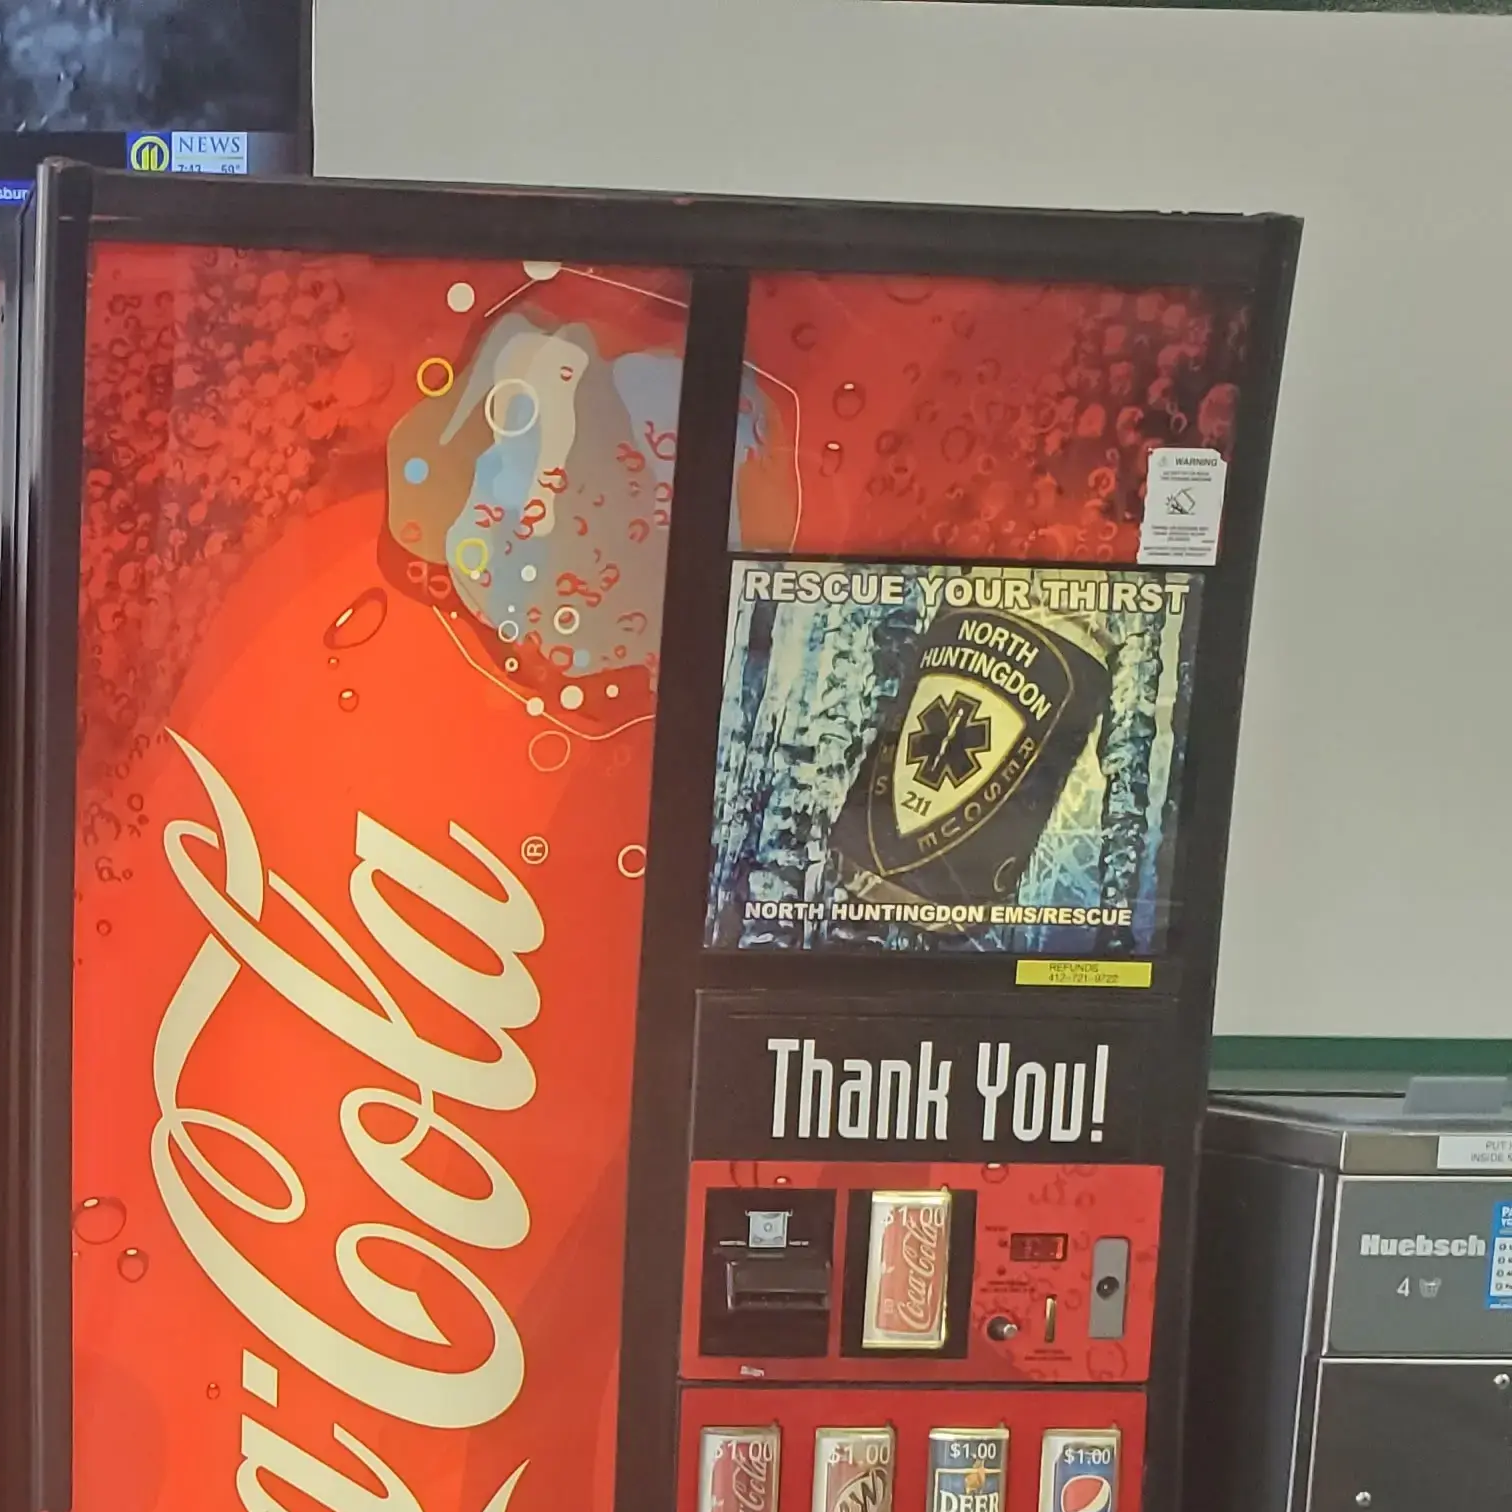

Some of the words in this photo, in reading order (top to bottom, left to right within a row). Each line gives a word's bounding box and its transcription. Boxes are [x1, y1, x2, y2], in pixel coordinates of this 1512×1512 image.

[179, 137, 240, 153] NEWS
[1175, 457, 1217, 466] WARNING
[745, 570, 904, 606] RESCUE
[918, 576, 1031, 609] YOUR
[1042, 580, 1190, 613] THIRST
[958, 619, 1039, 668] NORTH
[919, 646, 1052, 721] HUNTINGDON
[901, 791, 932, 816] 211
[744, 902, 824, 920] NORTH
[831, 903, 984, 922] HUNTINGDON
[990, 906, 1132, 926] EMS/RESCUE
[1049, 963, 1099, 972] REFUNDS
[767, 1038, 952, 1140] Thank
[976, 1042, 1109, 1143] You!
[1471, 1153, 1503, 1162] INSIDE
[1359, 1234, 1486, 1256] Huebsch
[1396, 1277, 1410, 1297] 4
[950, 1443, 996, 1459] $1.00
[1064, 1448, 1111, 1465] $1.00
